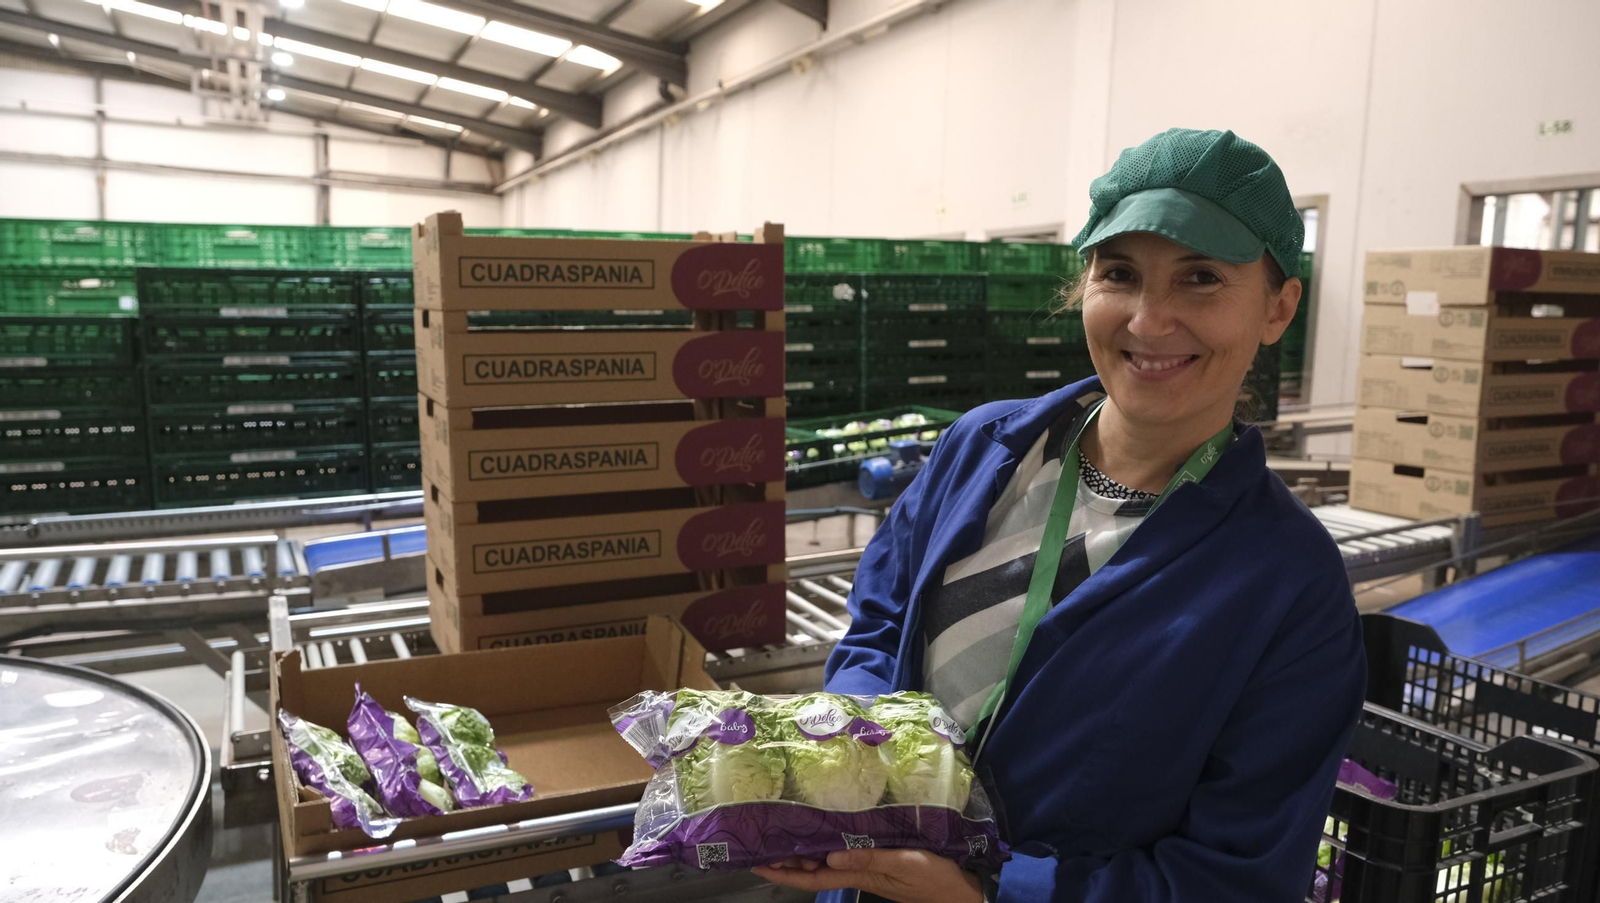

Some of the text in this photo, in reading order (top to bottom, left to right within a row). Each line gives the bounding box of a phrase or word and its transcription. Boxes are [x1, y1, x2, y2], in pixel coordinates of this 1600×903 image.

[471, 263, 643, 283] CUADRASPANIA
[475, 358, 645, 378] CUADRASPANIA
[480, 449, 647, 474] CUADRASPANIA
[485, 537, 650, 567] CUADRASPANIA
[720, 721, 748, 733] Baby
